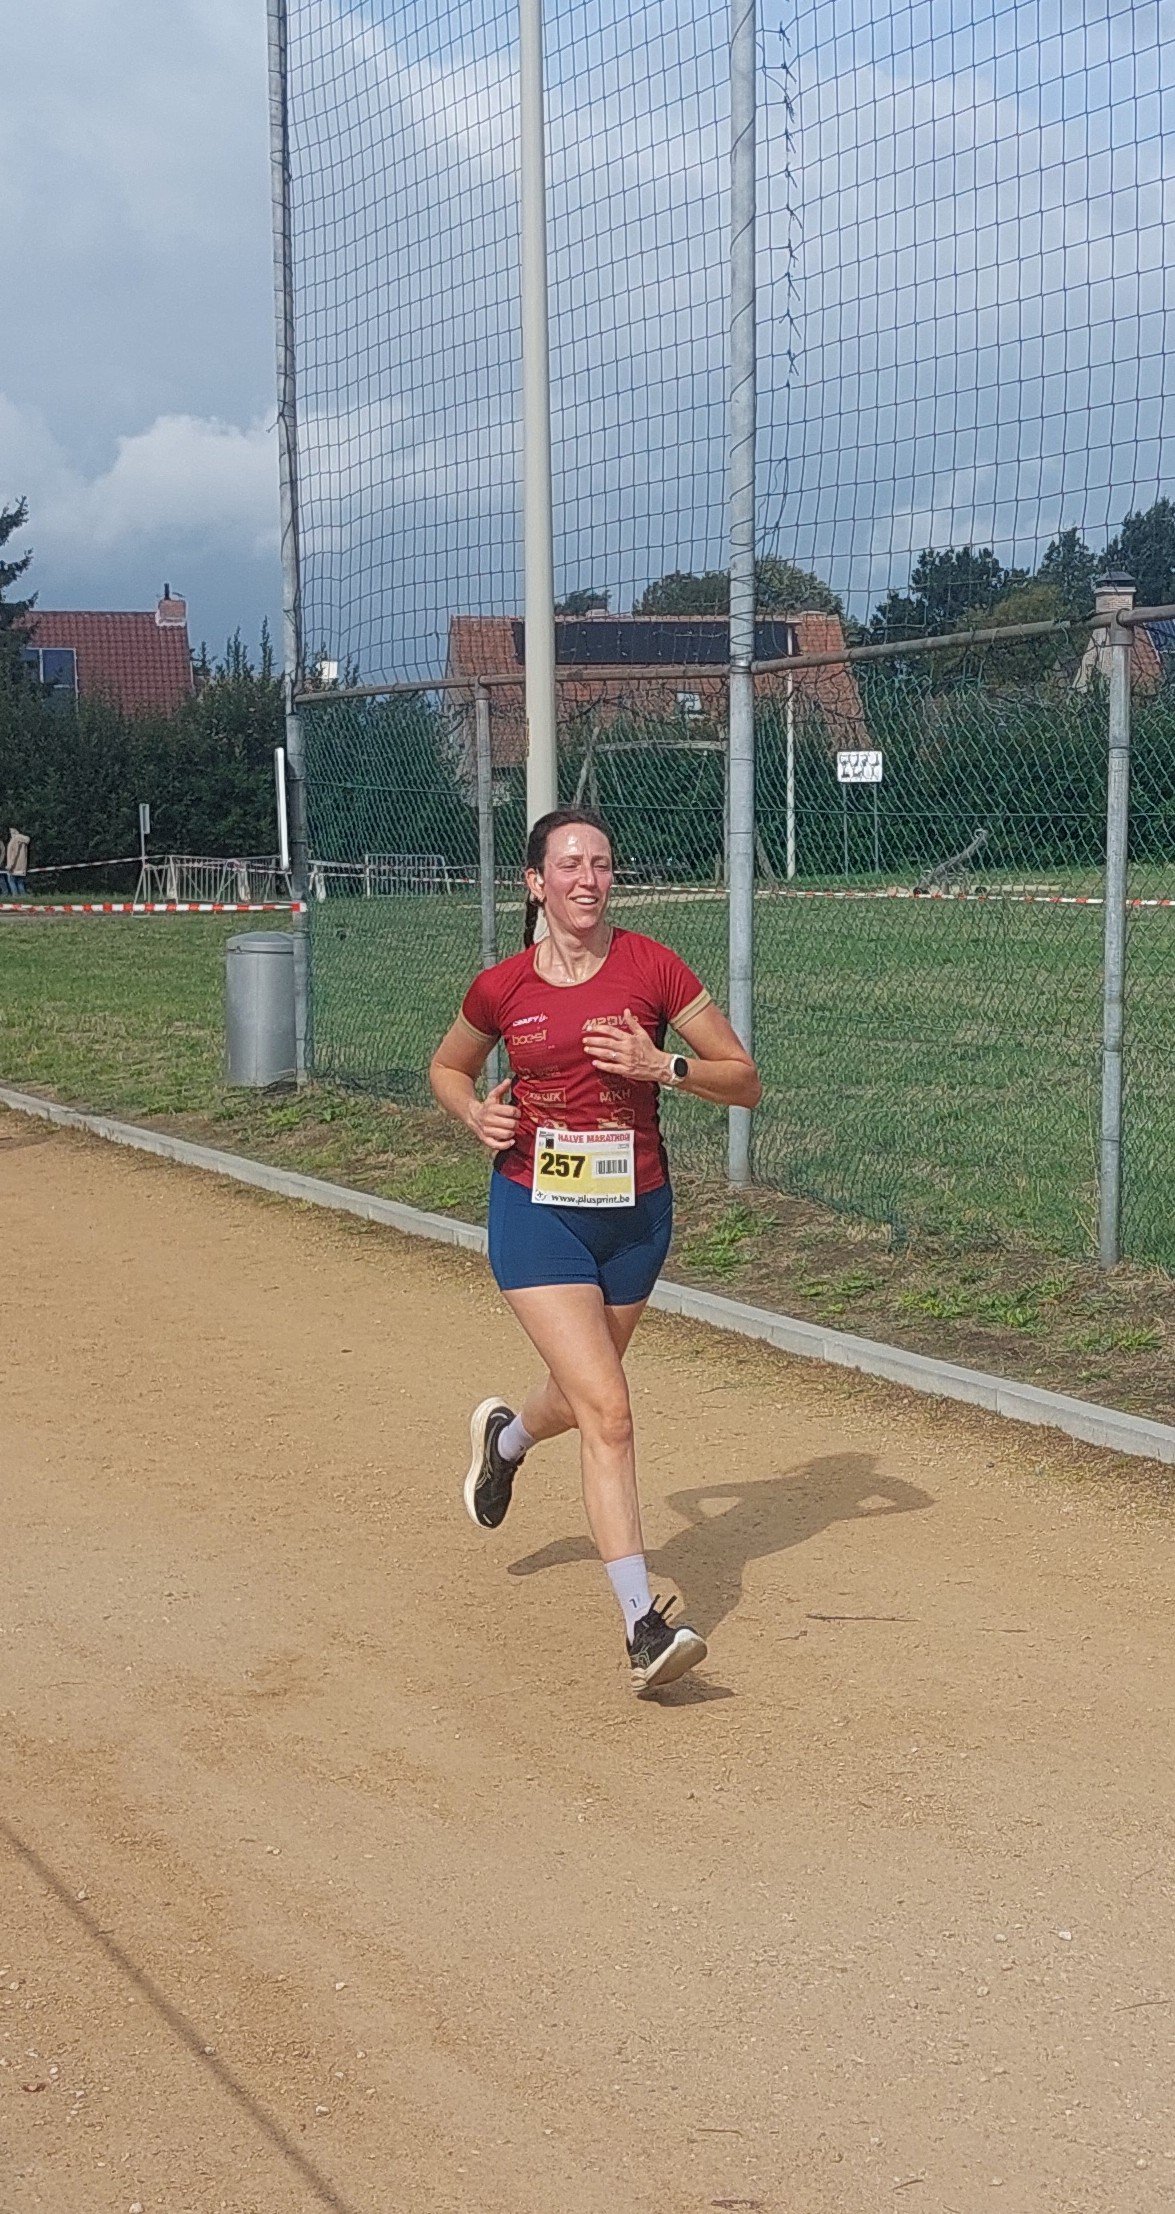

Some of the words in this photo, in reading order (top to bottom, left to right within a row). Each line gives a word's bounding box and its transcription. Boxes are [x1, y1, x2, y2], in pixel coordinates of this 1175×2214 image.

[557, 1134, 584, 1143] HALVE
[586, 1133, 630, 1143] MARATHON
[540, 1152, 586, 1178] 257
[551, 1193, 630, 1206] www.plusprint.be
